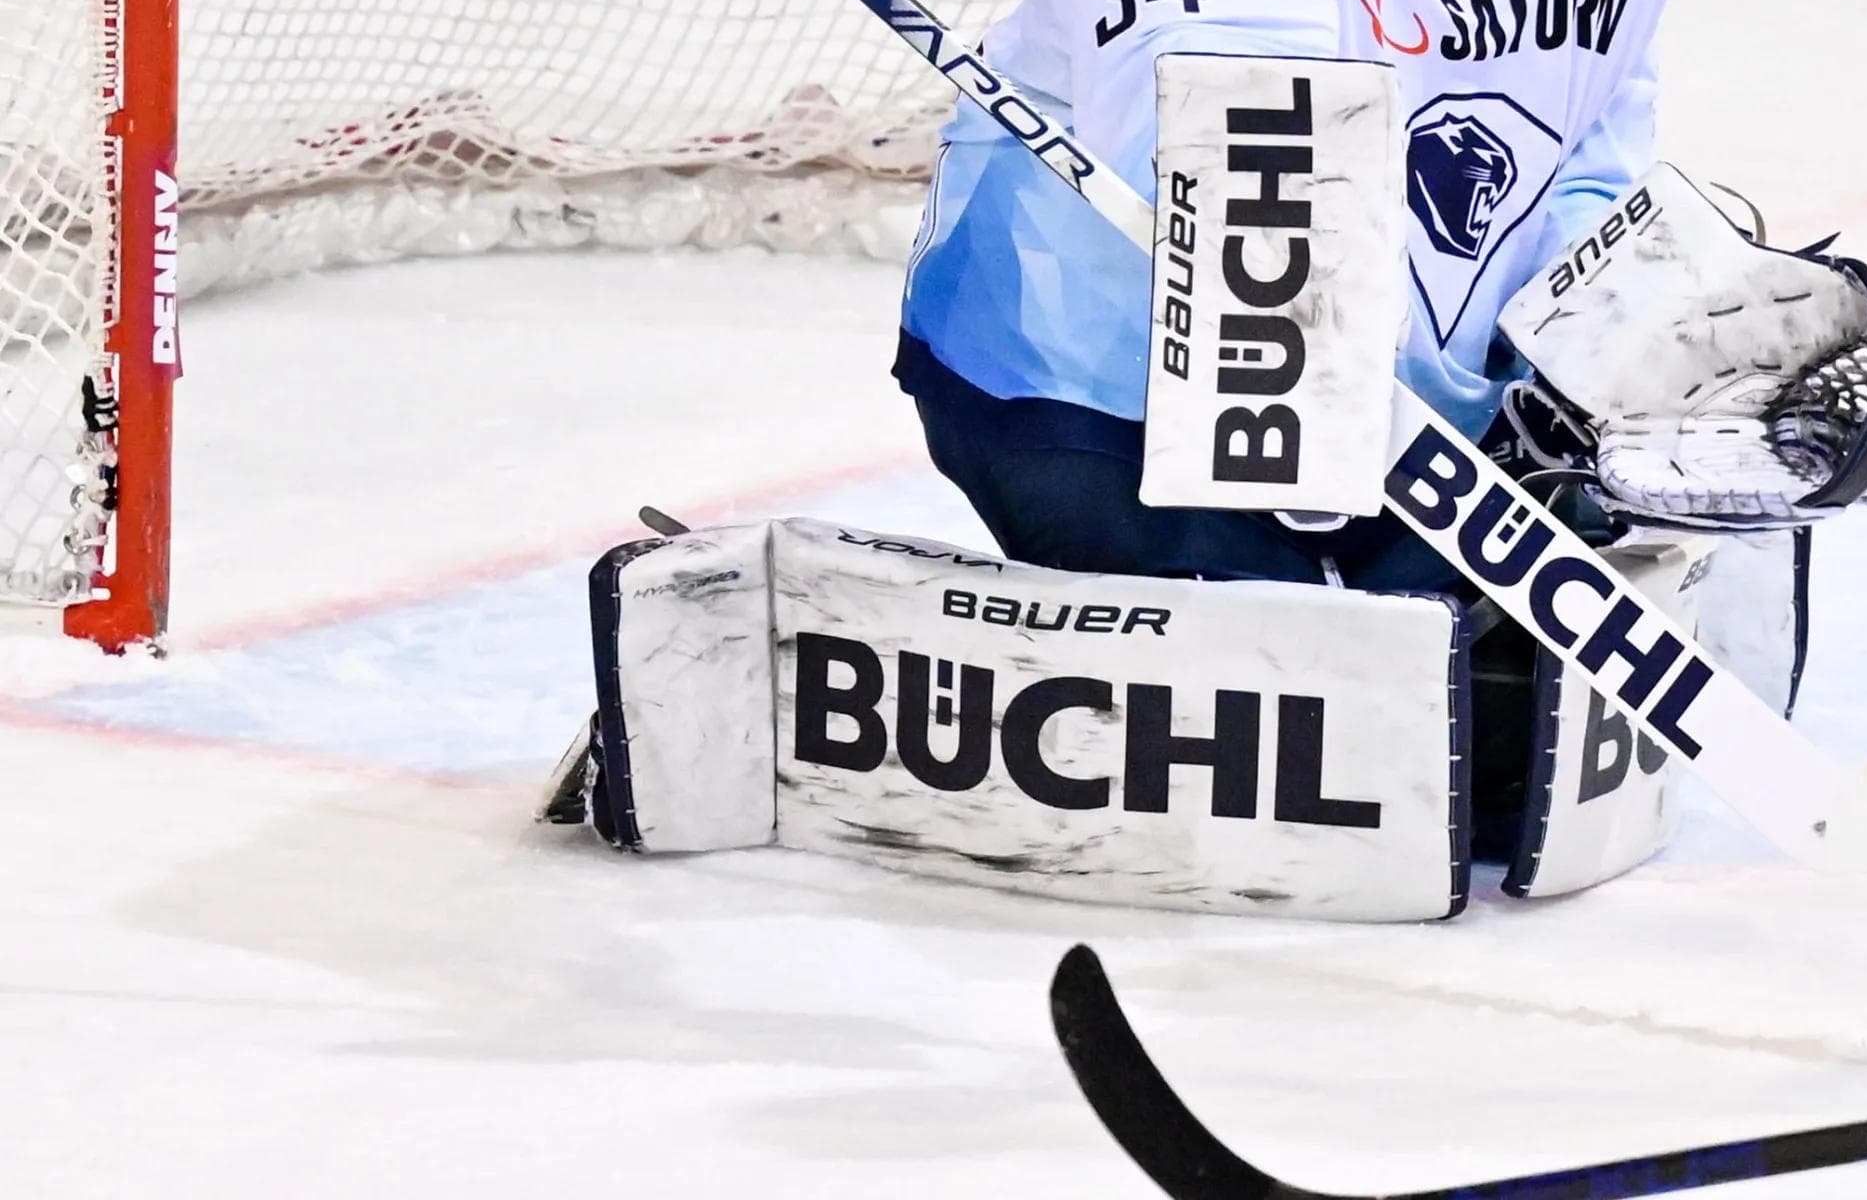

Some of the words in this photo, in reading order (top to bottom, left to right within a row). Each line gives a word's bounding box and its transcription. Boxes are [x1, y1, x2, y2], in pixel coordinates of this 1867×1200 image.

[1212, 76, 1314, 485] BÜCHL
[793, 632, 1382, 830] BÜCHL
[1384, 422, 1715, 761] BÜCHL
